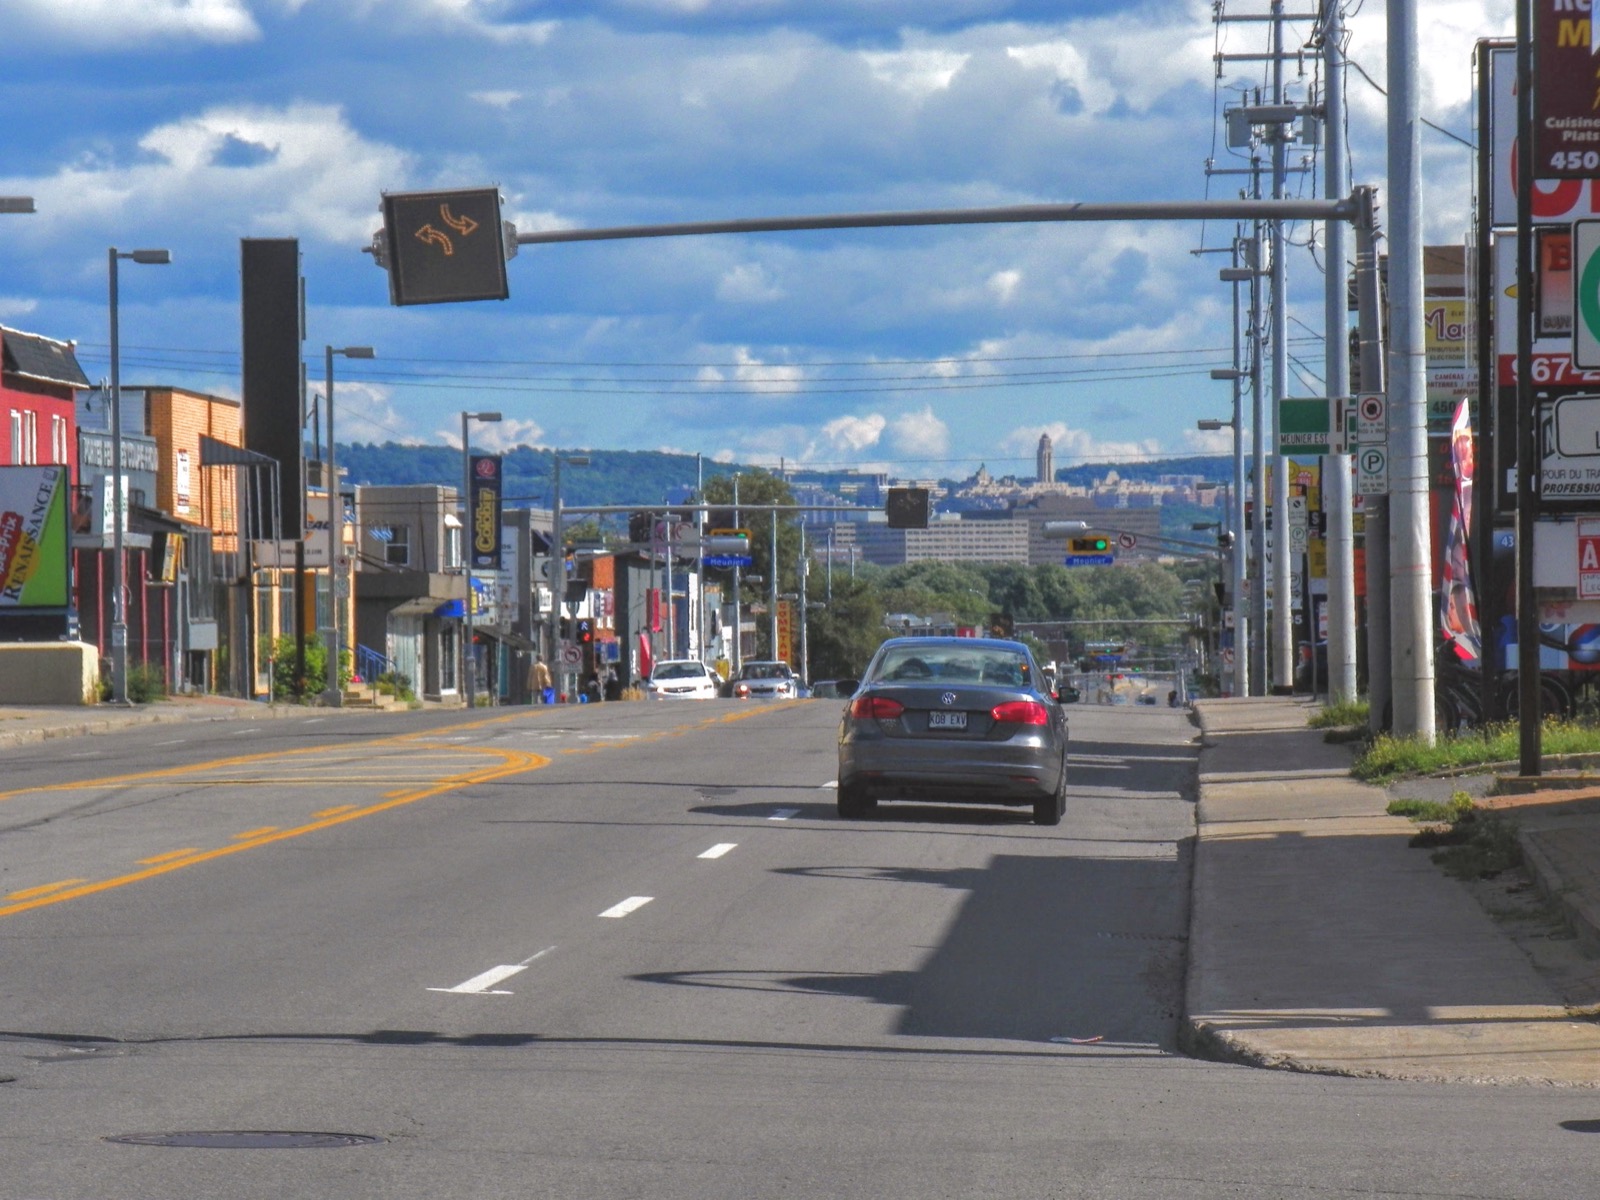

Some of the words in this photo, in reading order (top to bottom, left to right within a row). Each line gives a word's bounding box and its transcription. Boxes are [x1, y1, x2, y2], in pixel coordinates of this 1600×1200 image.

[1545, 117, 1600, 128] Cuisine
[1550, 151, 1599, 169] 450
[1281, 434, 1312, 444] MEUNIER
[1542, 470, 1566, 479] POUR
[1570, 470, 1581, 479] DU
